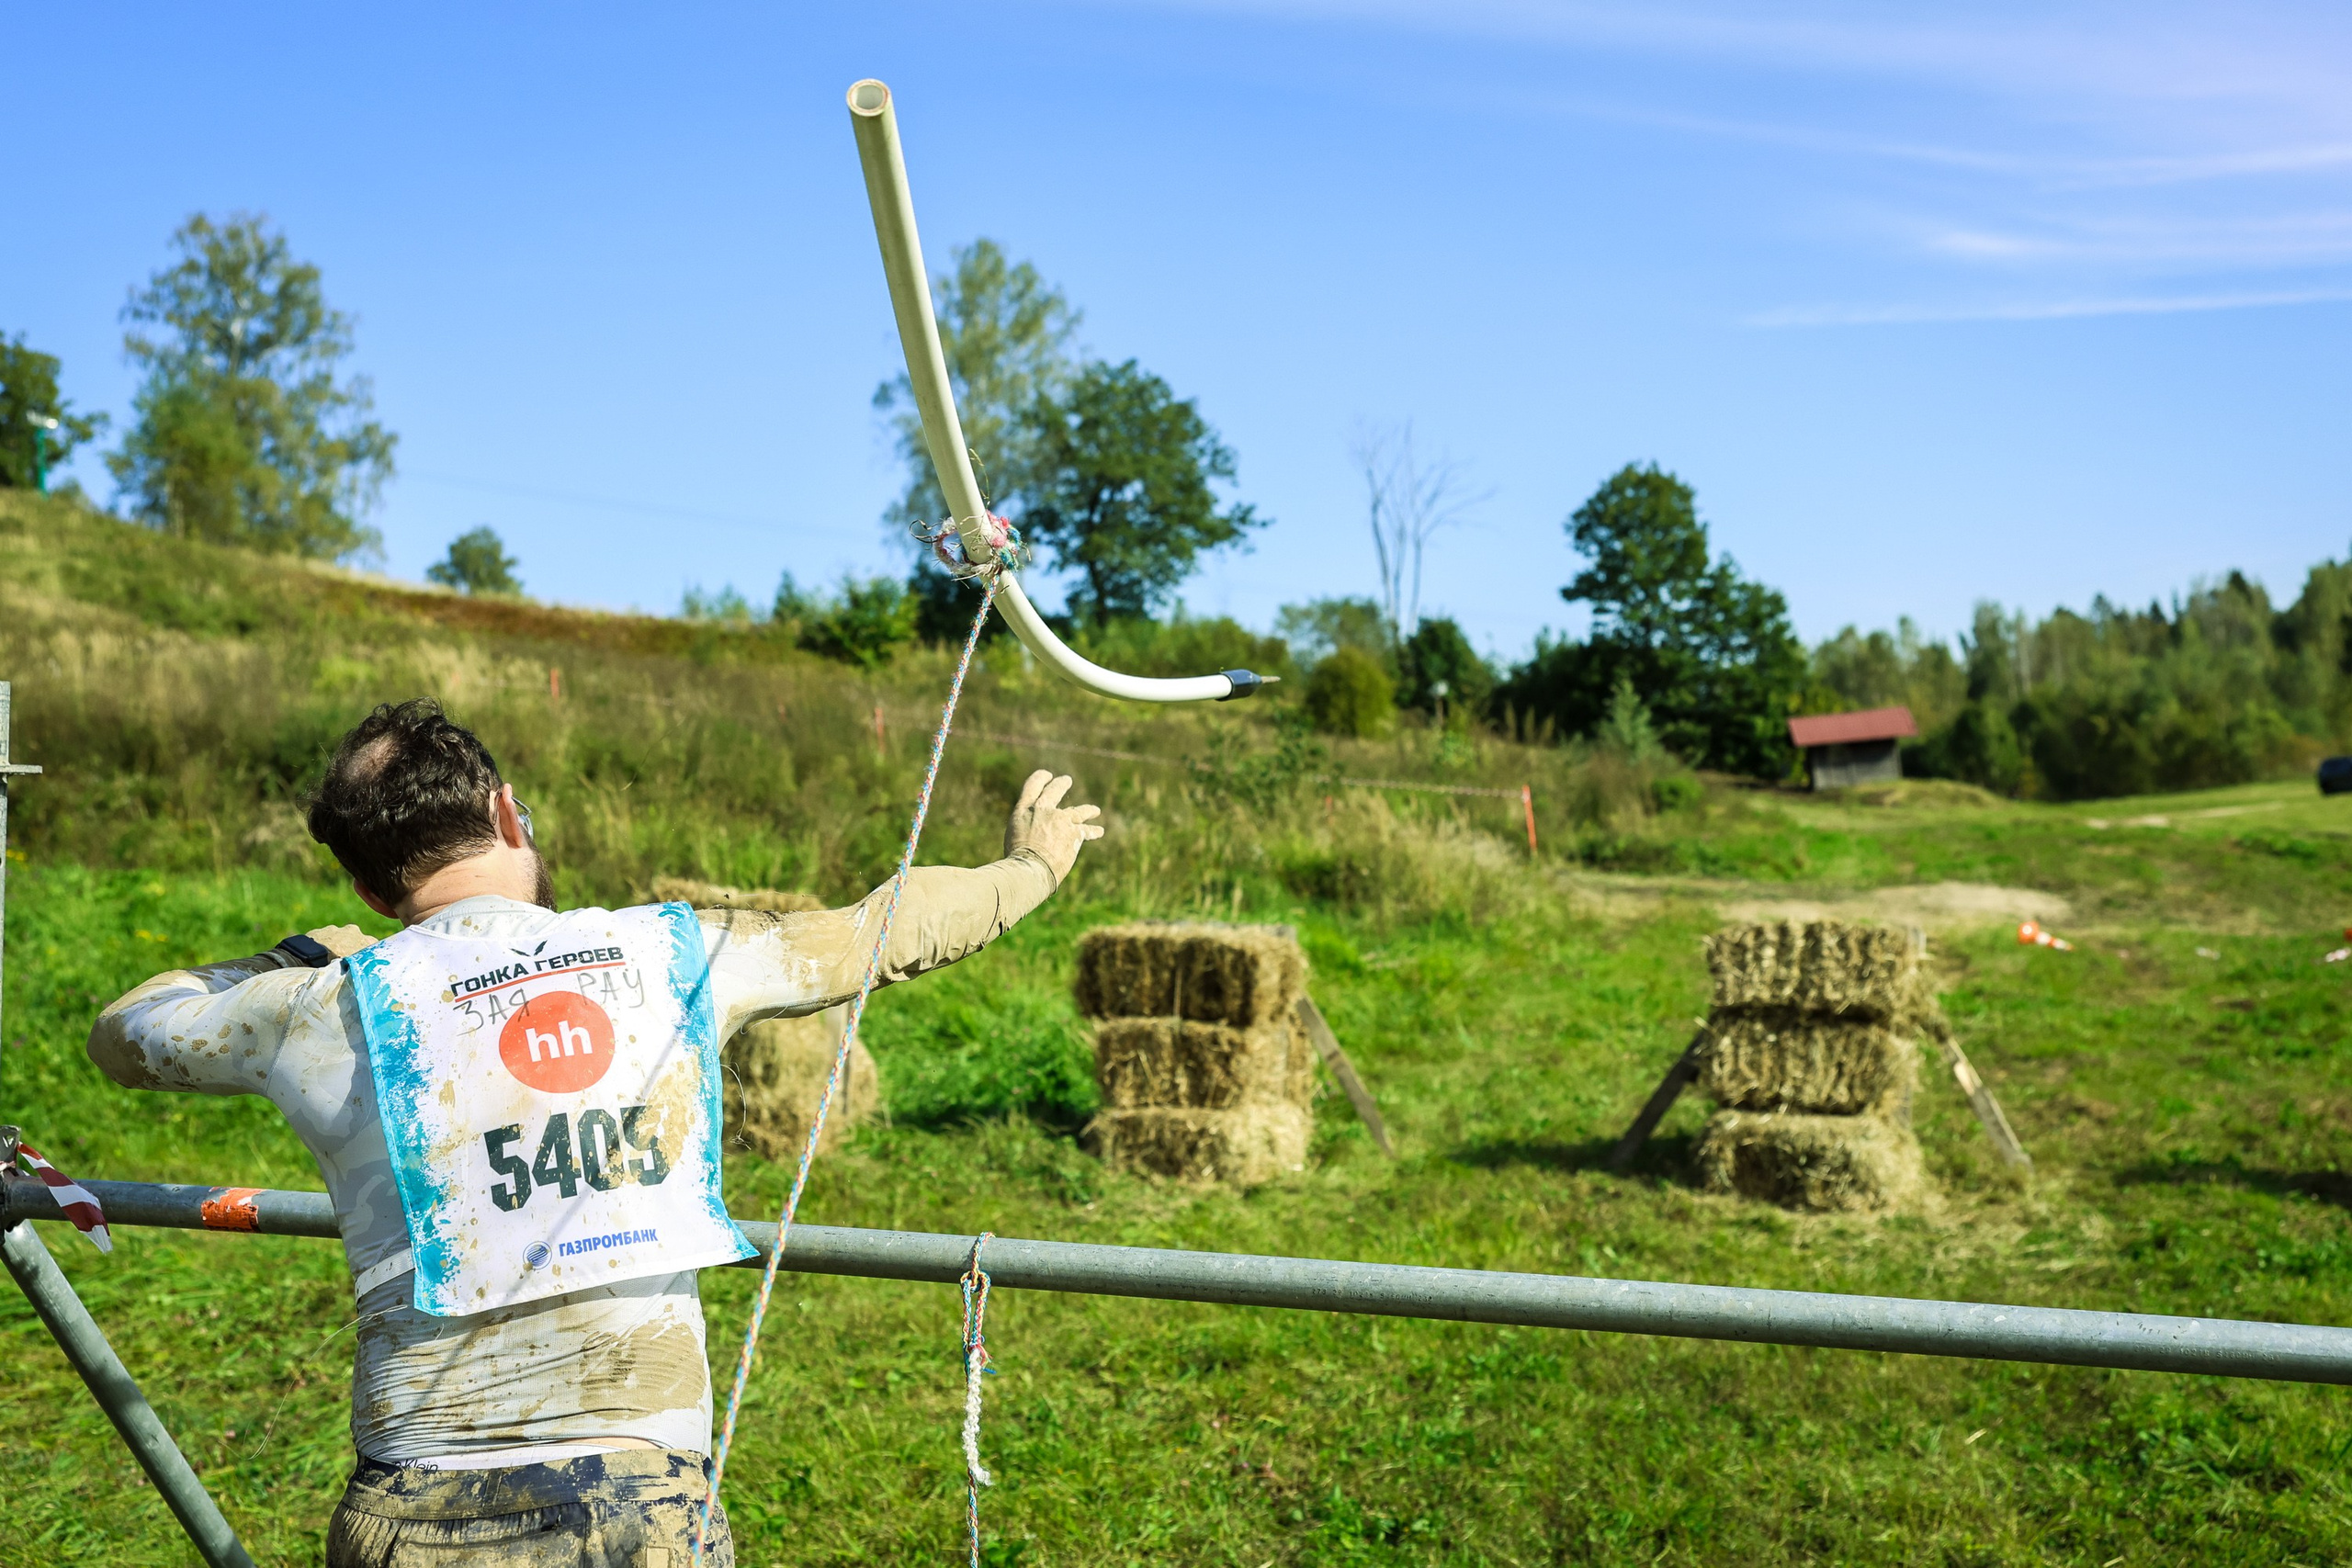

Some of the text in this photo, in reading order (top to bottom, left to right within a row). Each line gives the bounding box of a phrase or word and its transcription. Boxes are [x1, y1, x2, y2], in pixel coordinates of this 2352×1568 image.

[450, 946, 625, 998] ГОНКА ГЕРОЕВ
[525, 1020, 594, 1063] hh
[559, 1228, 659, 1257] ГАЗПРОМБАНК
